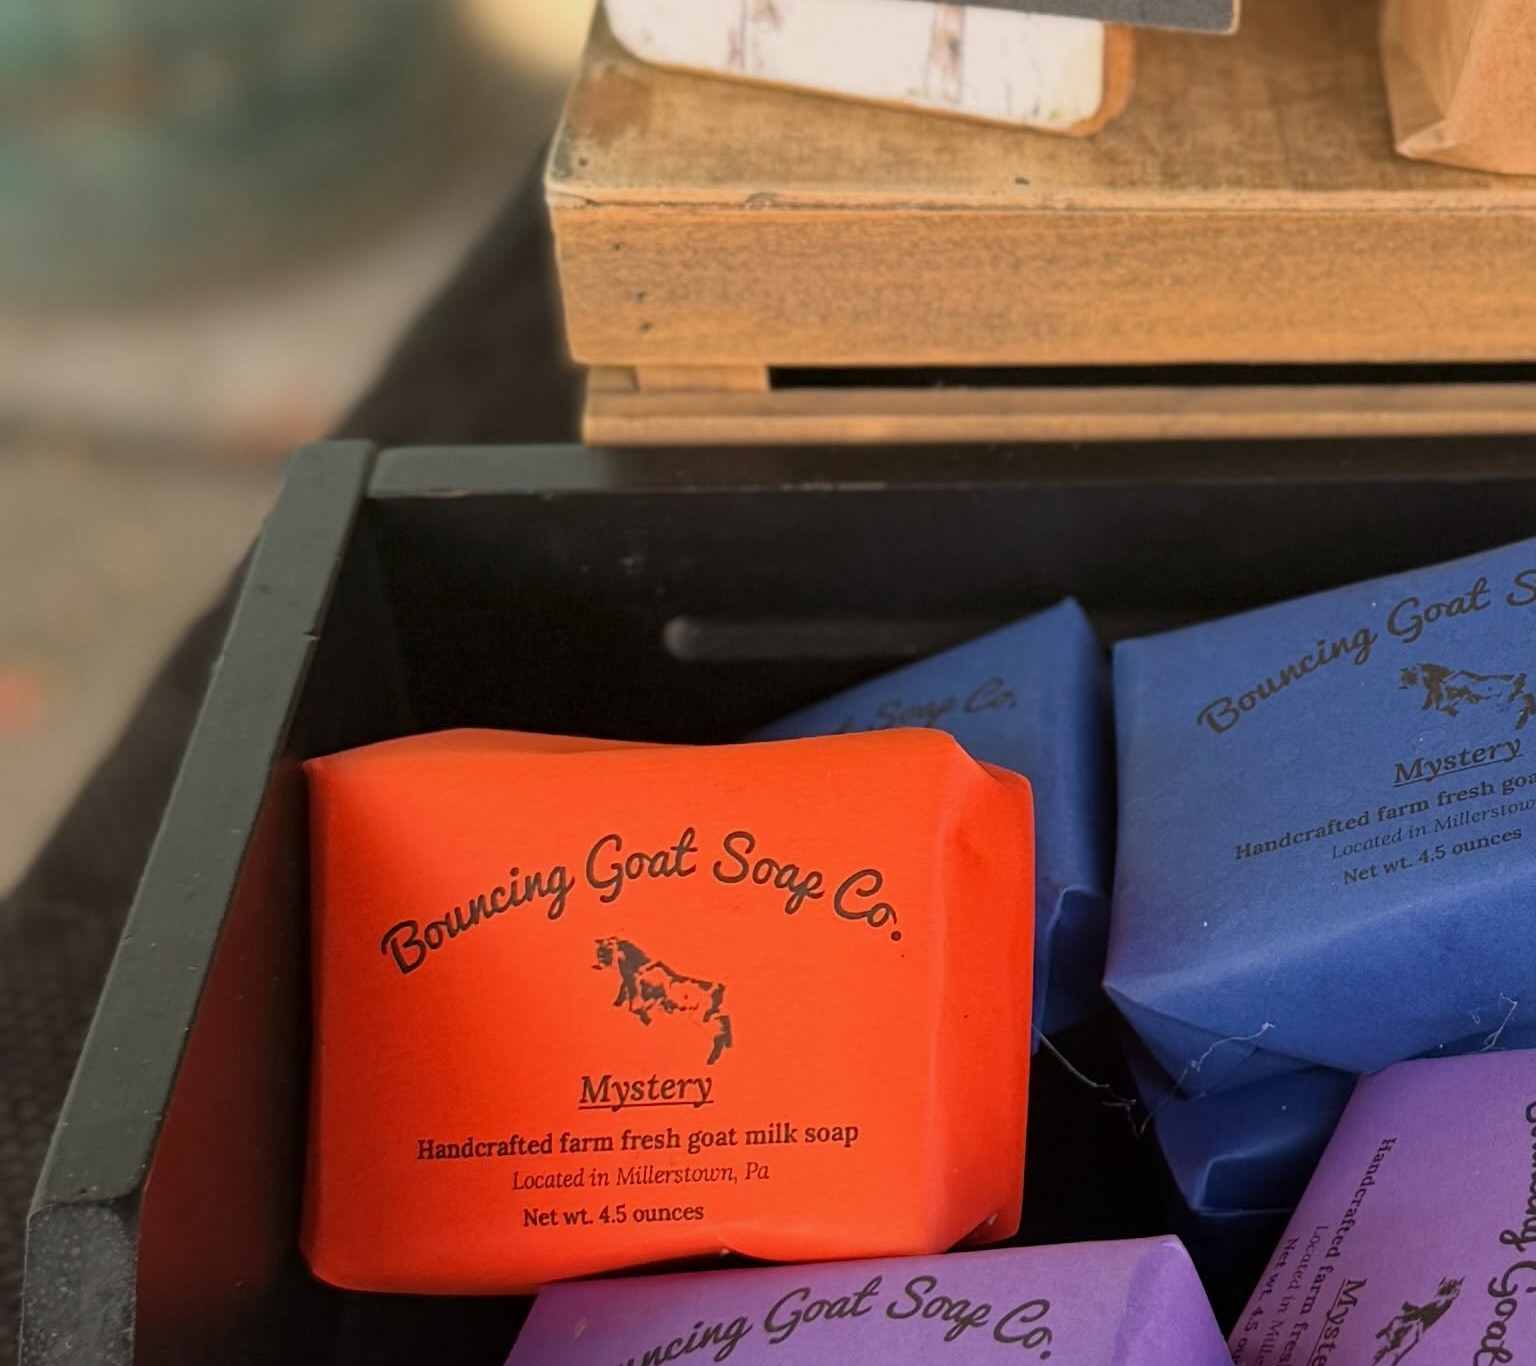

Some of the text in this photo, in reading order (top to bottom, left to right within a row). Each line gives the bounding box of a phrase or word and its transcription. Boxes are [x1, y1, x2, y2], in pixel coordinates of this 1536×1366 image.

[1196, 629, 1379, 734] Bouncing
[1388, 577, 1491, 643] Goat
[1392, 738, 1524, 787] Mystery
[1234, 810, 1370, 861] Handcrafted
[1377, 795, 1430, 821] farm
[1437, 782, 1495, 809] fresh
[1331, 833, 1403, 861] Located
[1408, 824, 1427, 841] in
[1343, 828, 1523, 885] Net wt. 4.5 ounces
[380, 827, 902, 975] Bouncing Goat Soap Co.
[578, 1074, 714, 1111] Mystery
[417, 1122, 859, 1160] Handcrafted farm fresh goat milk soap
[512, 1162, 769, 1191] Located in Millerstown, Pa
[1326, 1137, 1397, 1258] Handcrafted
[523, 1204, 704, 1227] Net wt. 4.5 ounces
[1274, 1236, 1299, 1269] Net
[1288, 1226, 1328, 1291] Located
[1278, 1295, 1295, 1314] in
[1301, 1265, 1334, 1314] farm
[764, 1275, 883, 1344] Goat
[887, 1276, 989, 1341] Soap
[992, 1298, 1053, 1359] Co.
